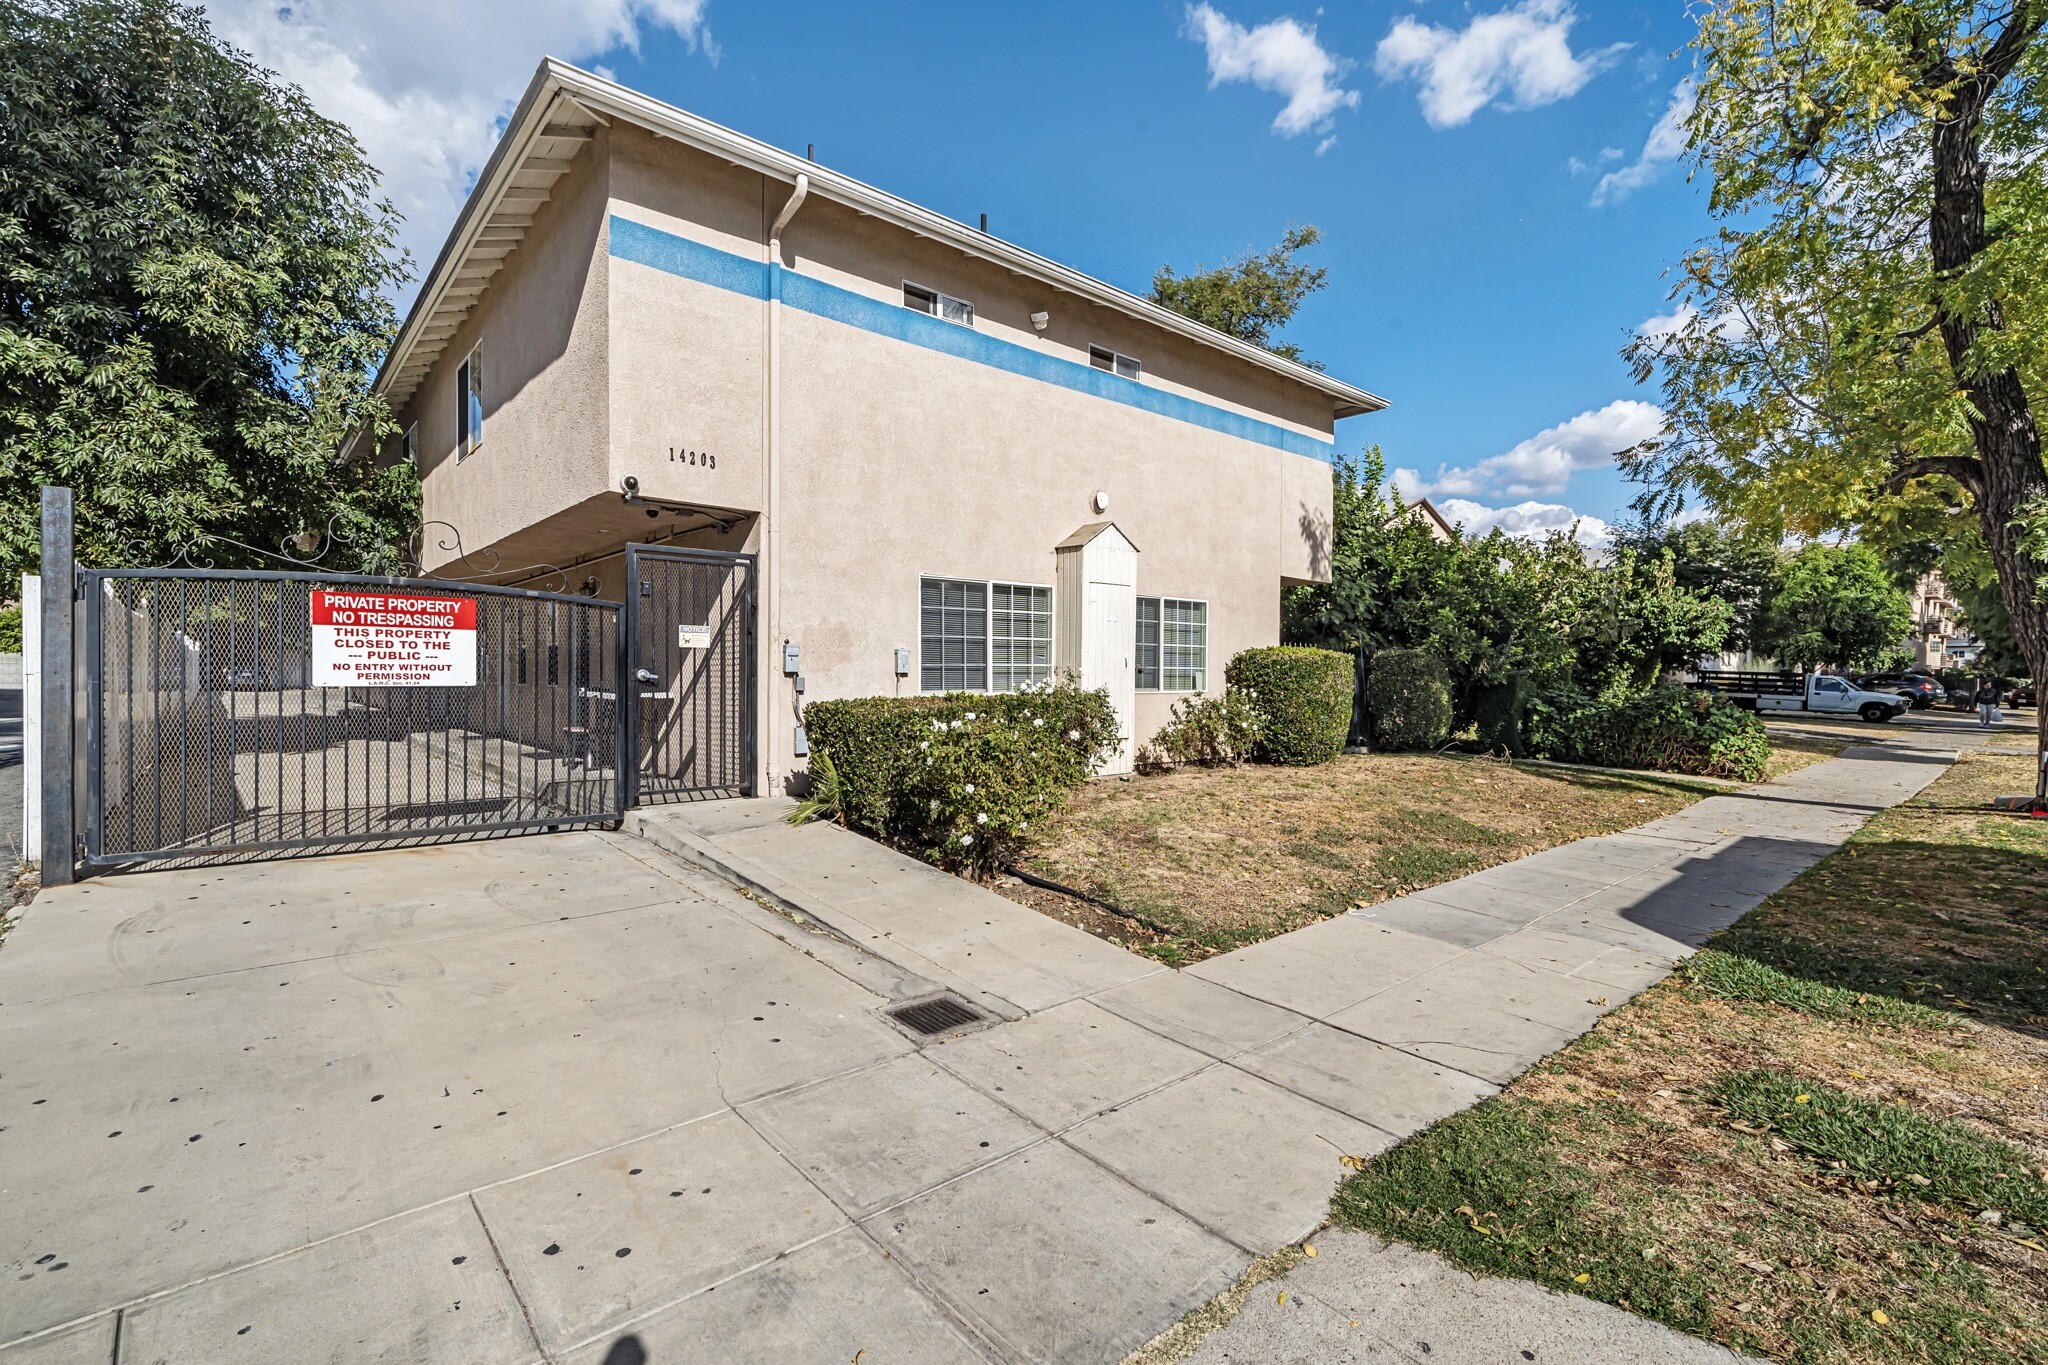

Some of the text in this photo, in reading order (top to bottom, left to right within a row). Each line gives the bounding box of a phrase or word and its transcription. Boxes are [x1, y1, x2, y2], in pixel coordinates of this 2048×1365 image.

[669, 447, 716, 470] 14203
[325, 595, 461, 613] PRIVATE PROPERTY
[332, 611, 454, 627] NO TRESPASSING
[334, 628, 451, 639] THIS PROPERTY
[334, 639, 451, 650] CLOSED TO THE
[368, 651, 421, 660] PUBLIC
